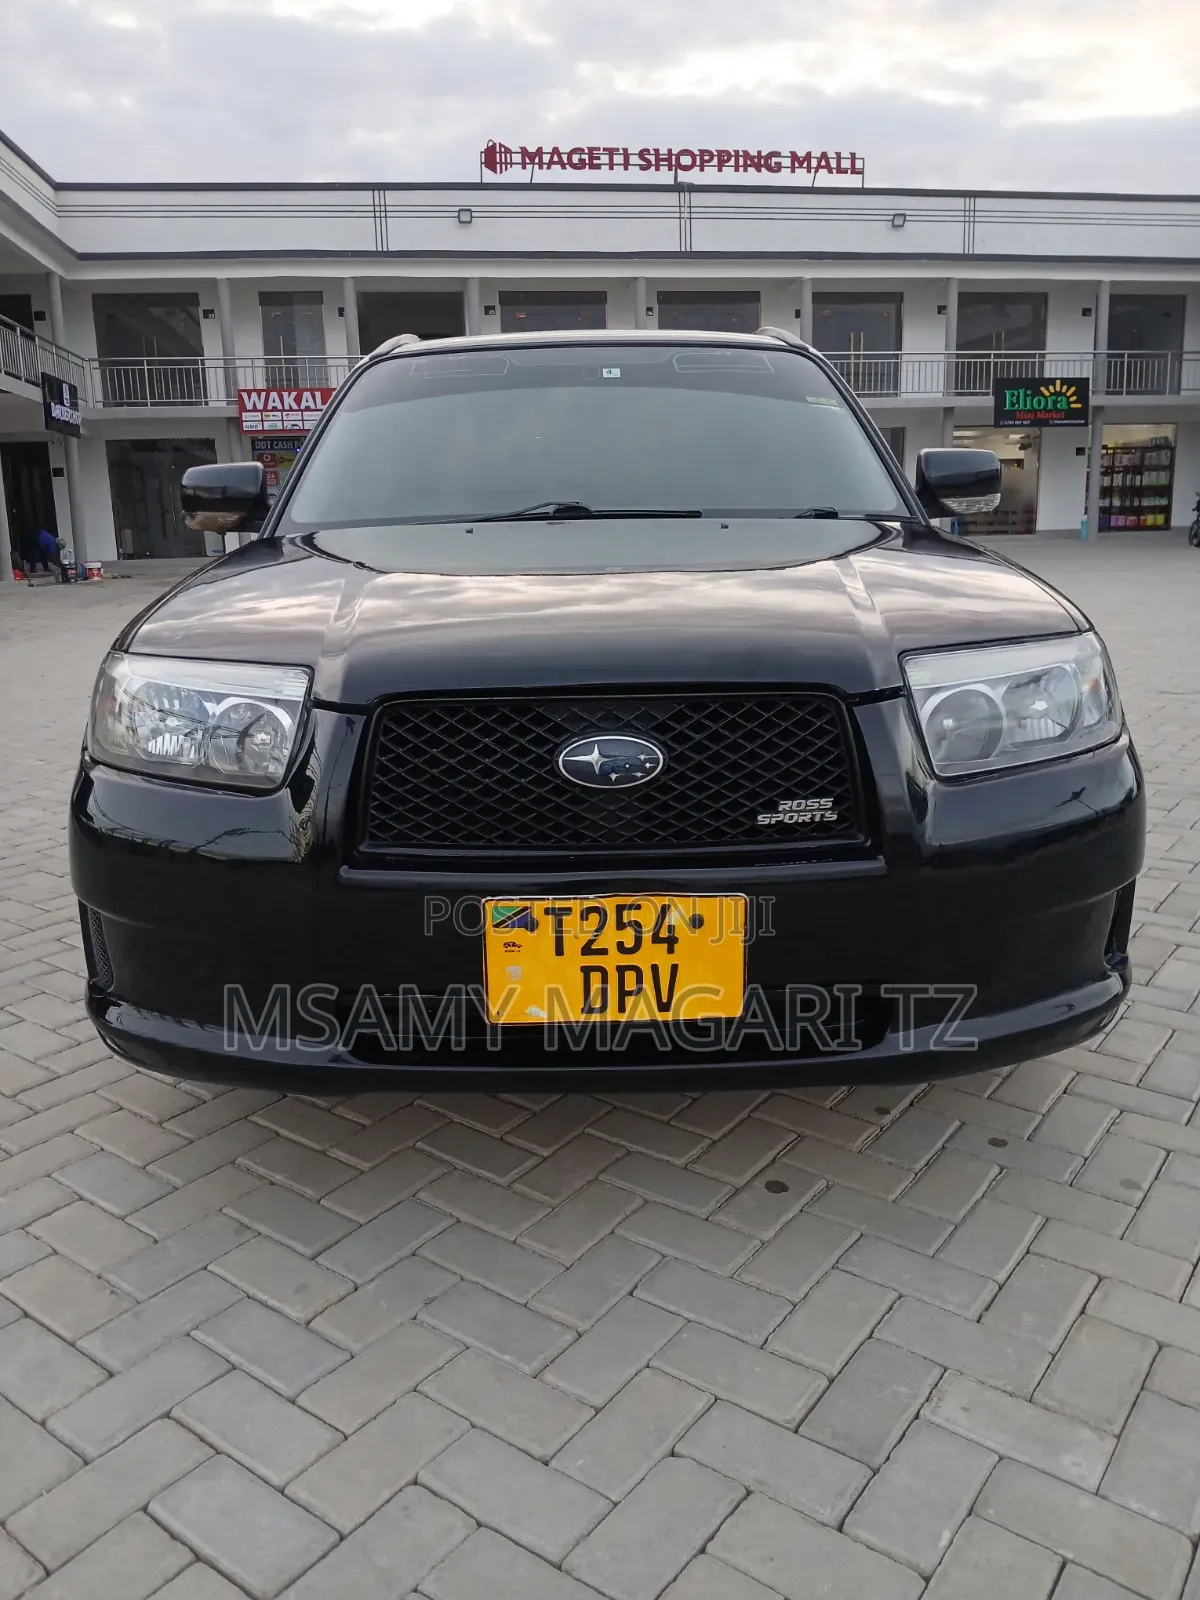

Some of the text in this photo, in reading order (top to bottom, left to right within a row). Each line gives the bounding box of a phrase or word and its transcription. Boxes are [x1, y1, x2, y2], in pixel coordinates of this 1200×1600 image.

[520, 146, 864, 175] MAGETI SHOPPING MALL
[1003, 388, 1069, 410] Eliora
[1016, 410, 1065, 419] Mini Market
[273, 440, 293, 450] CASH
[778, 798, 834, 811] ROSS
[757, 810, 839, 825] SPORTS
[543, 903, 680, 957] T254
[580, 962, 680, 1015] DPV
